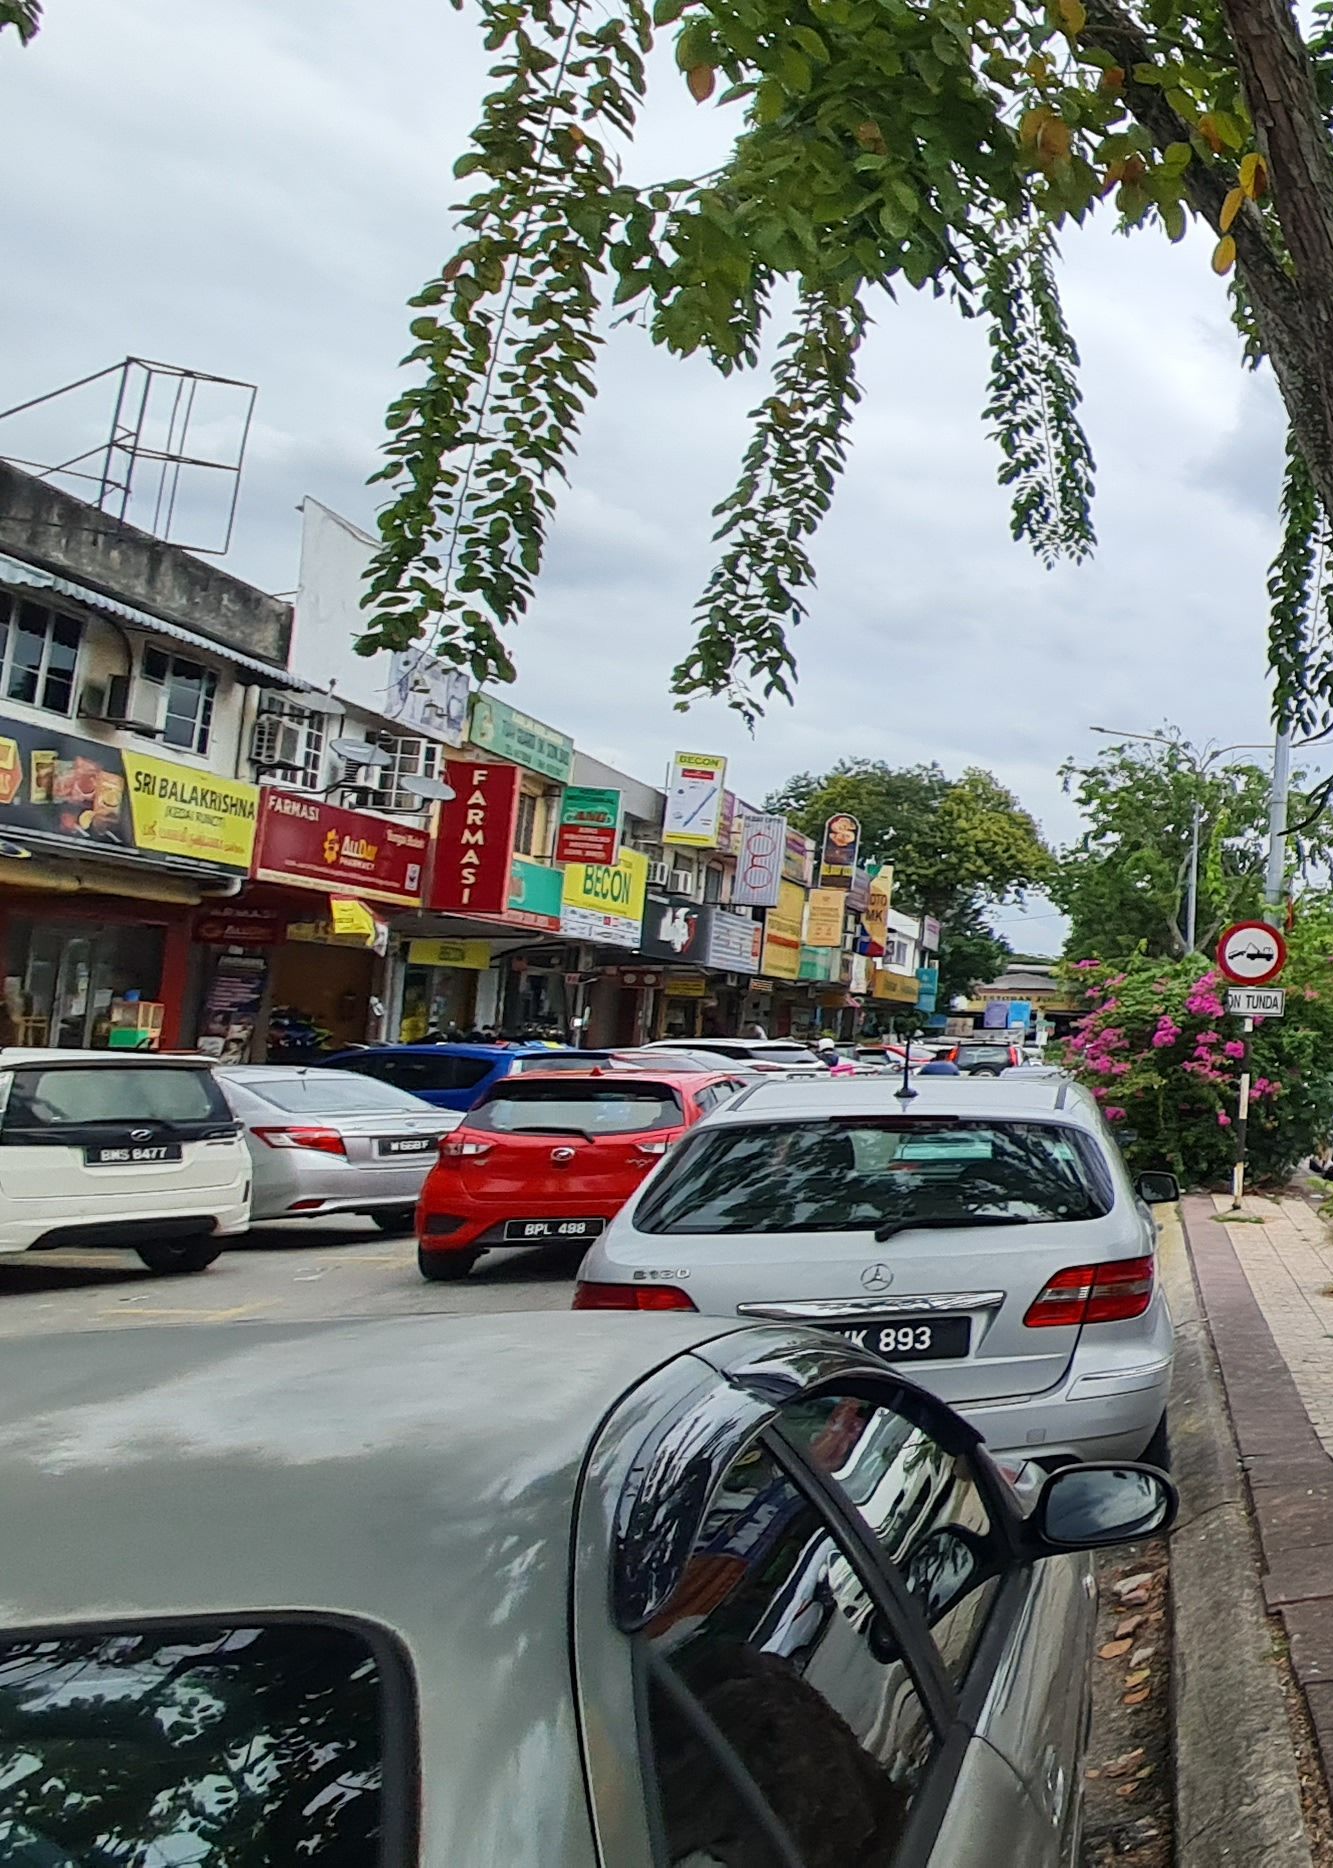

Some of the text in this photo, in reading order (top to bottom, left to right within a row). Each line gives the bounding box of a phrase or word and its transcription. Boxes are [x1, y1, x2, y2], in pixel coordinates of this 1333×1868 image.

[134, 771, 256, 820] SRI BALAKRISHNA
[267, 796, 320, 821] FARMASI
[460, 769, 488, 905] FARMASI
[583, 864, 632, 905] BECON
[1246, 994, 1279, 1009] TUNDA
[525, 1223, 552, 1236] BPL
[879, 1326, 931, 1351] 893
